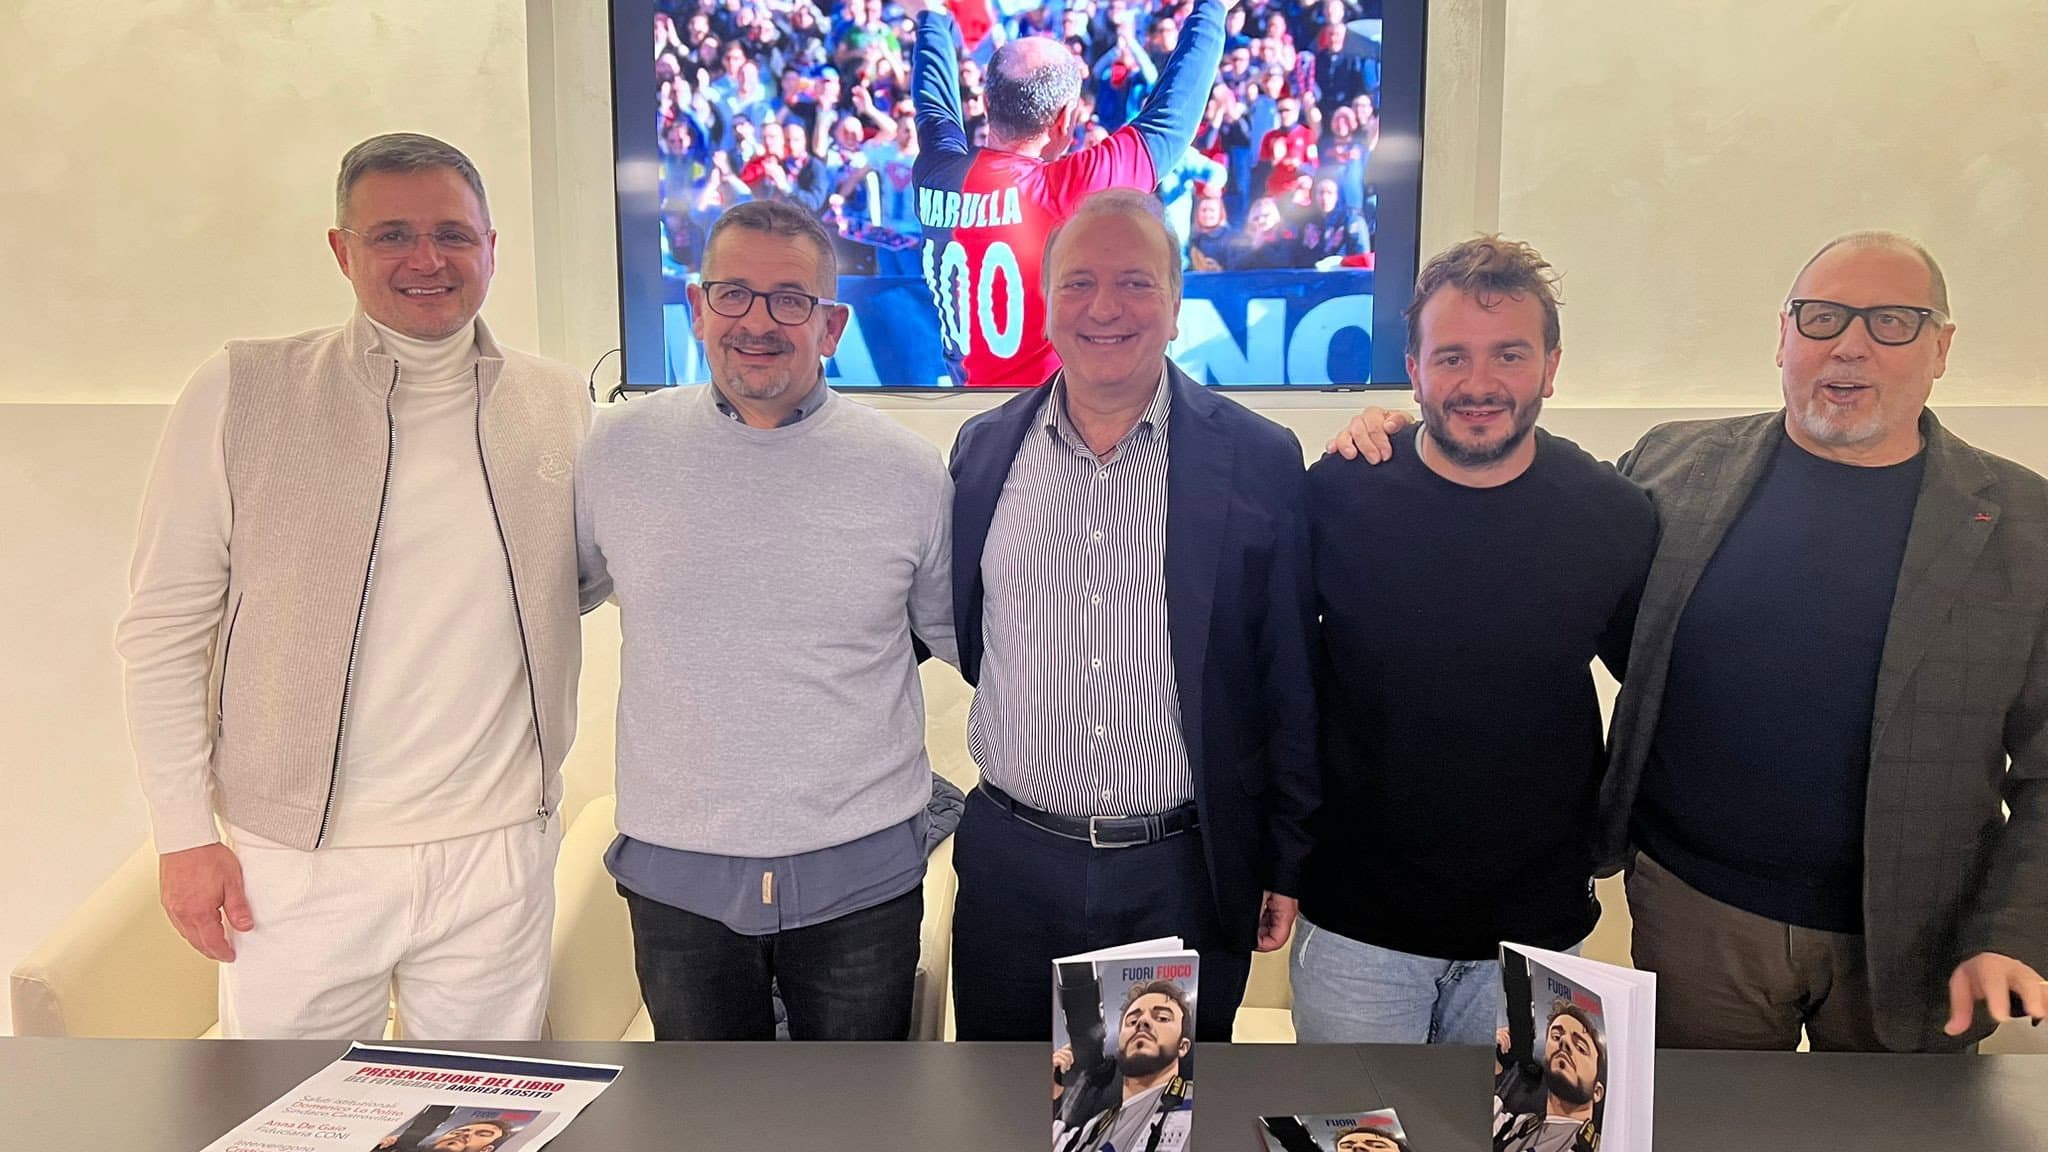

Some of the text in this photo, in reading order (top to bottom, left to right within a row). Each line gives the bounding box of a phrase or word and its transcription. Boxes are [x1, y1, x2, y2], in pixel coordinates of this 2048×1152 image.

[1122, 964, 1192, 981] FUORI FUOCO
[1547, 977, 1572, 1001] FUORI
[355, 1066, 565, 1093] PRESENTAZIONE DEL LIBRO
[446, 1084, 500, 1095] ANDREA
[500, 1088, 554, 1099] ROSITO
[264, 1120, 296, 1129] Anna
[297, 1122, 316, 1130] De
[313, 1130, 351, 1140] CONI
